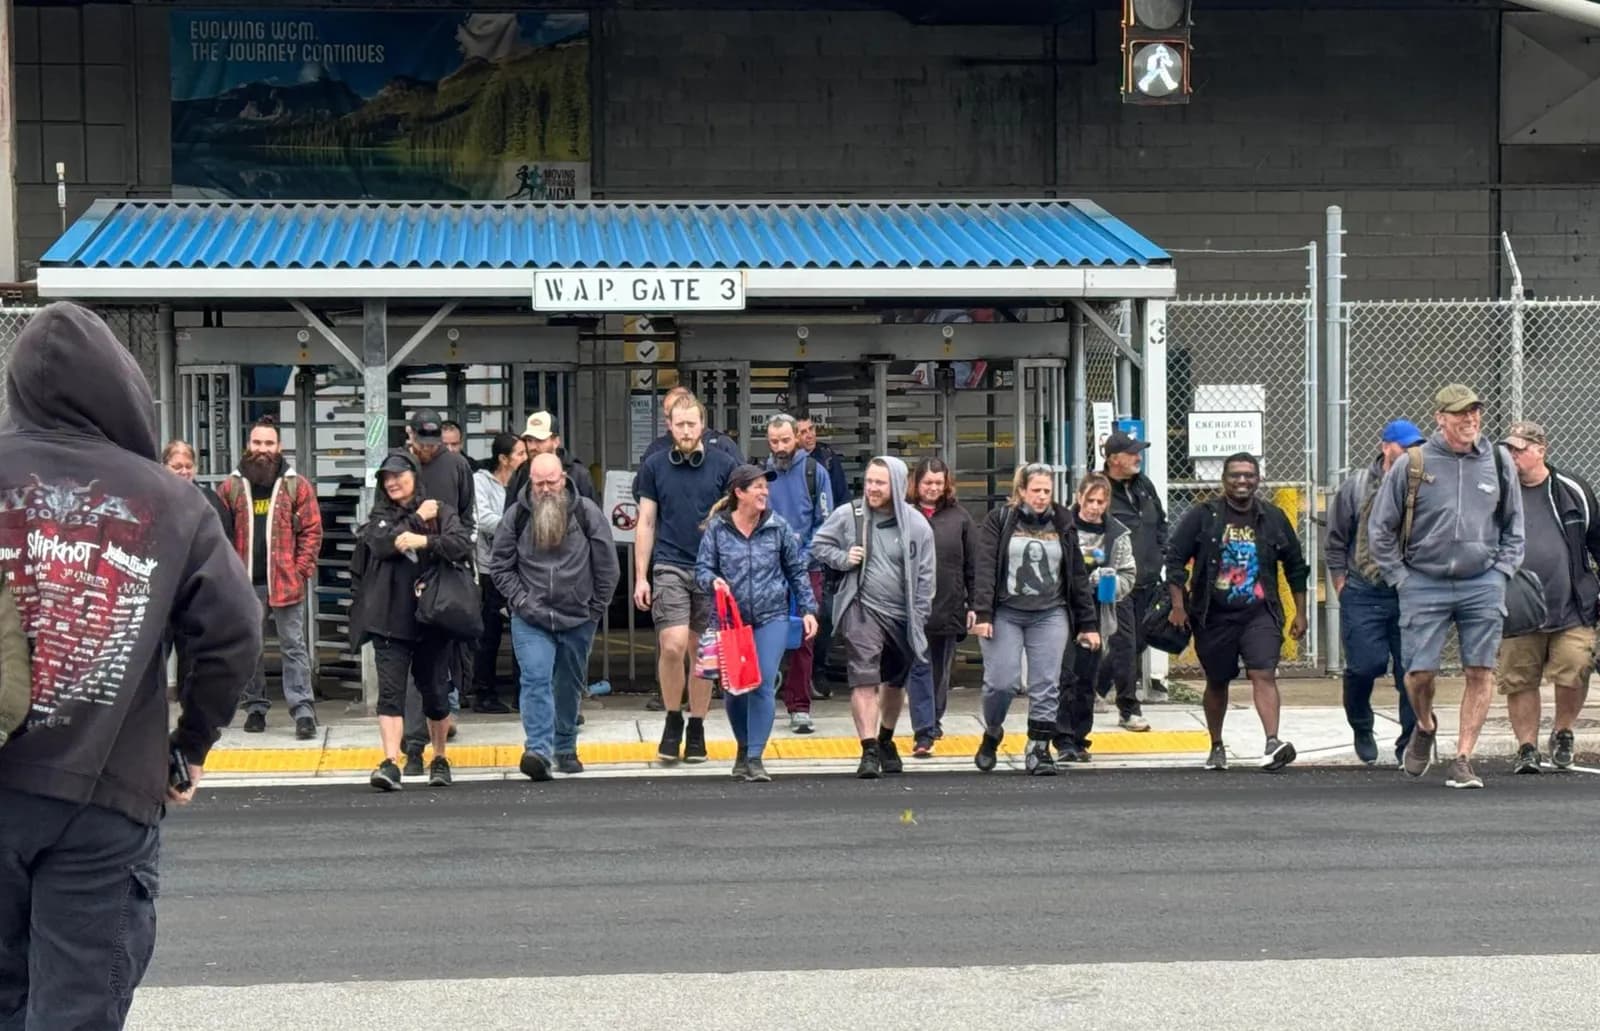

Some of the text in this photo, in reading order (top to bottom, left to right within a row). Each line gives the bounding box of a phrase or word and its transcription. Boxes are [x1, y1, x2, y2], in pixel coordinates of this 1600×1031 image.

[190, 20, 265, 39] EVOLVING
[191, 42, 385, 63] THE JOURNEY CONTINUES
[544, 168, 576, 179] MOVING
[632, 278, 700, 301] GATE
[720, 278, 736, 301] 3
[1215, 430, 1237, 439] EXIT
